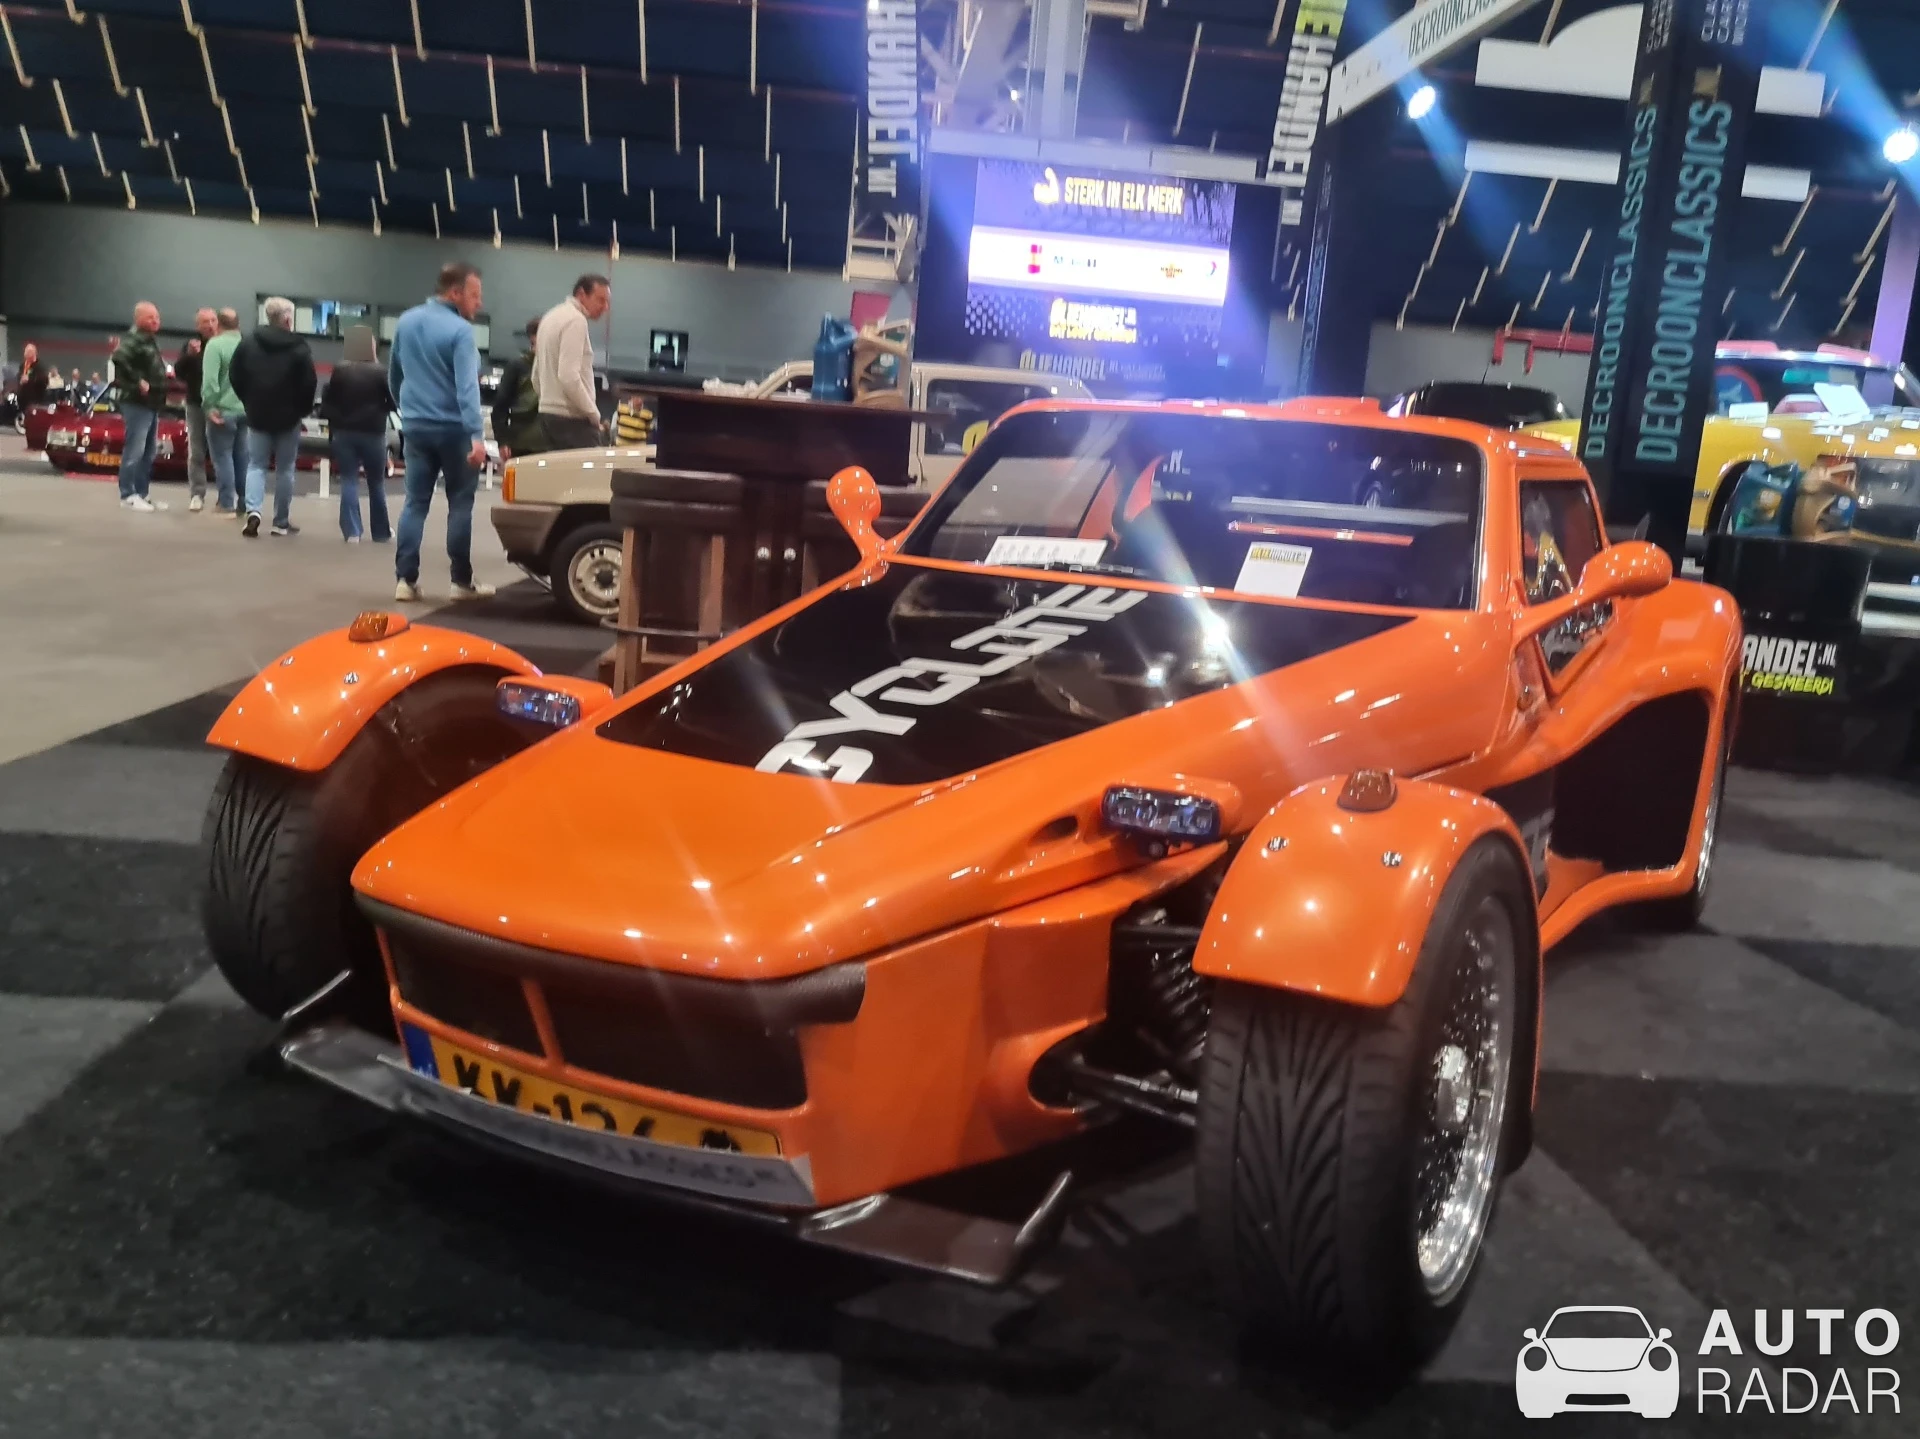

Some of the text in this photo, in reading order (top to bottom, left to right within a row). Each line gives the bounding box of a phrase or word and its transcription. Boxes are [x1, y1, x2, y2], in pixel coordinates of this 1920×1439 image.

[1065, 177, 1184, 215] STERK IN ELK MERK
